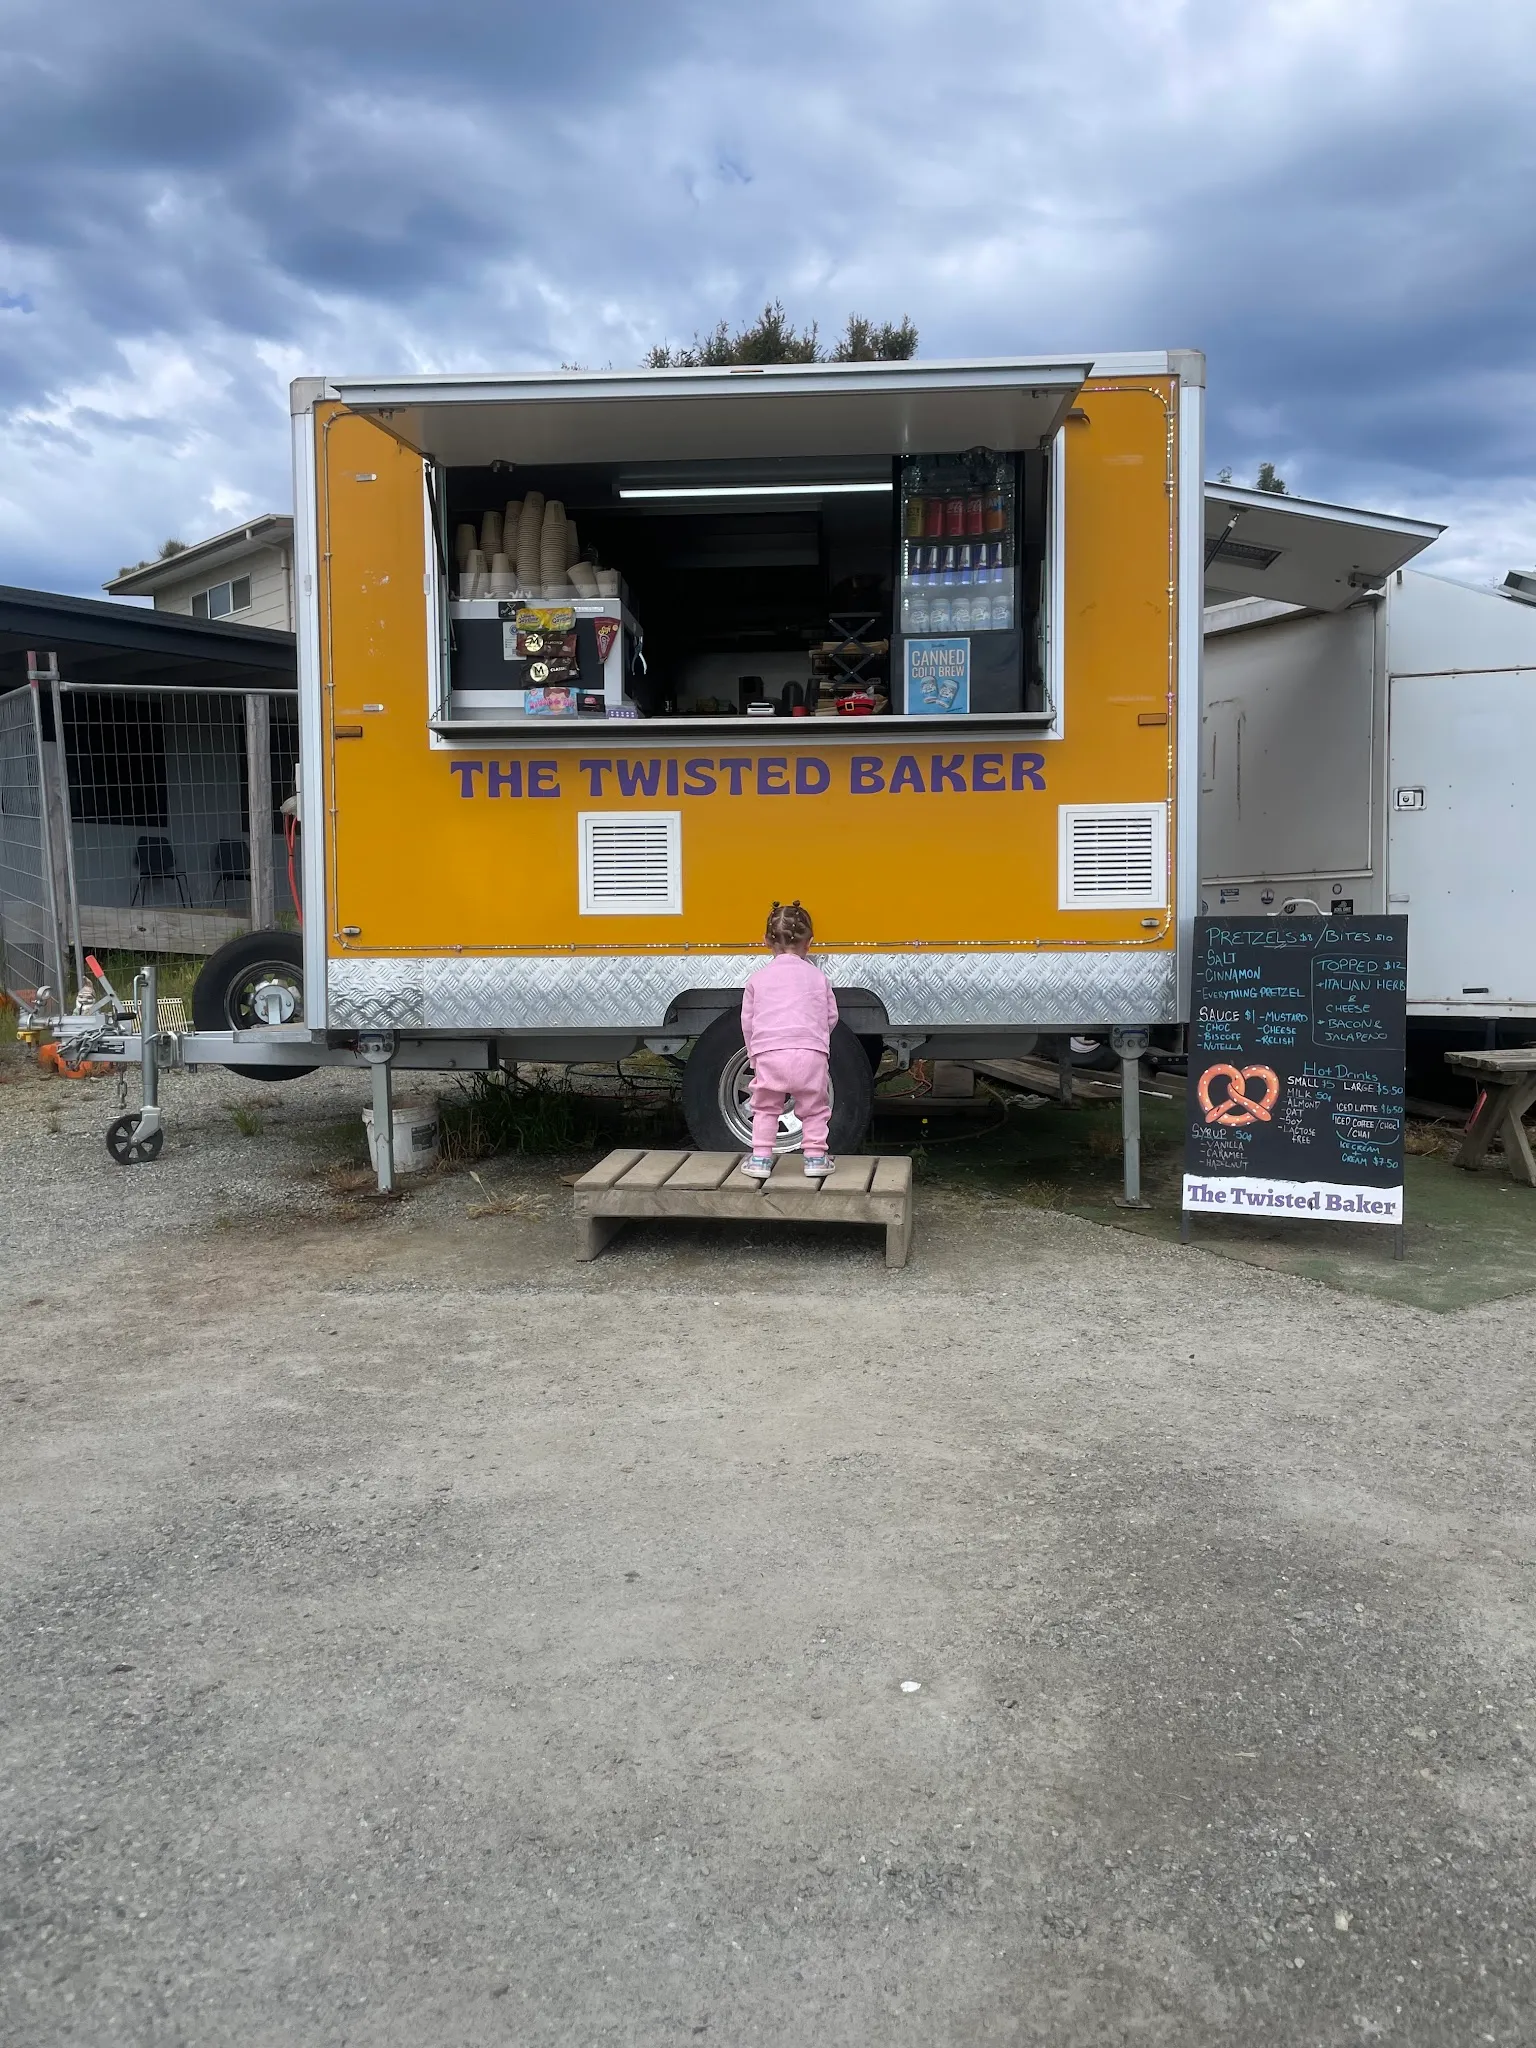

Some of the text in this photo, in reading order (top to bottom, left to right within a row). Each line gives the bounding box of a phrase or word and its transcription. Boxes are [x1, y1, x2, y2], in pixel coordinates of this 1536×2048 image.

[911, 649, 965, 666] CANNED
[911, 665, 965, 678] COLD BREW
[450, 753, 1046, 798] THE TWISTED BAKER
[1206, 927, 1298, 946] PRETZELS
[1207, 949, 1236, 966] SALT
[1317, 958, 1378, 973] TOPPED
[1205, 967, 1261, 983] CINNAMON
[1324, 979, 1371, 991] ITALIAN
[1202, 986, 1305, 1000] EVERYTHING PRETZEL
[1199, 1006, 1240, 1021] SAUCE
[1325, 1004, 1371, 1013] CHEESE
[1265, 1011, 1308, 1023] MUSTARD
[1205, 1023, 1231, 1032] CHOC
[1262, 1024, 1297, 1035] CHEESE
[1328, 1019, 1372, 1028] BACON
[1203, 1032, 1241, 1041] BISCOFF
[1261, 1036, 1294, 1047] RELISH
[1203, 1042, 1243, 1051] NUTELLA
[1303, 1061, 1332, 1076] Hot
[1287, 1076, 1319, 1088] SMALL
[1343, 1082, 1374, 1092] LARGE
[1287, 1088, 1312, 1099] MILK
[1287, 1098, 1320, 1109] ALMOND
[1336, 1103, 1353, 1112] ICED
[1355, 1104, 1378, 1113] LATTE
[1286, 1108, 1304, 1117] OAT
[1192, 1123, 1227, 1140] SYRUP
[1206, 1140, 1244, 1151] VANILLA
[1206, 1149, 1247, 1160] CARAMEL
[1187, 1183, 1396, 1215] The Twisted Baker
